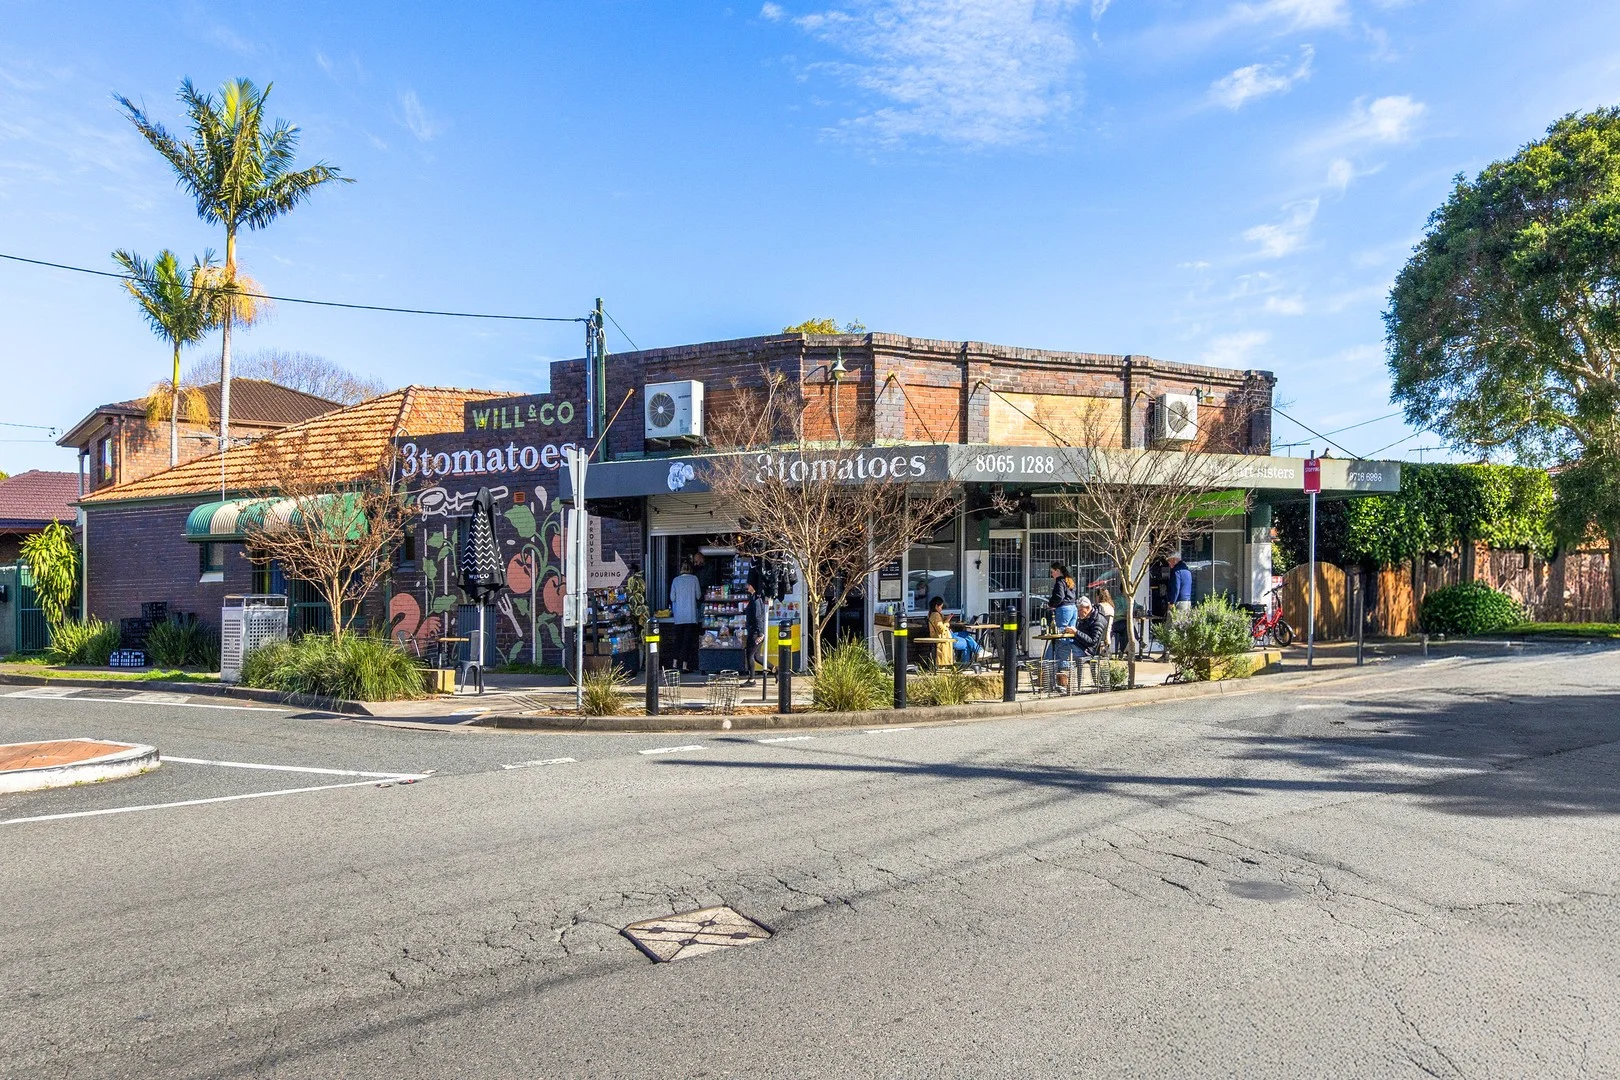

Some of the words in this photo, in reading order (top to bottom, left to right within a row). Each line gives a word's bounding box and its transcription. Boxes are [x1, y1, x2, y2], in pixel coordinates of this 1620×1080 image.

[401, 441, 577, 477] 3tomatoes
[755, 451, 926, 484] 3tomatoes
[975, 454, 1015, 473] 8065
[1020, 455, 1054, 474] 1288
[1257, 464, 1295, 479] sisters
